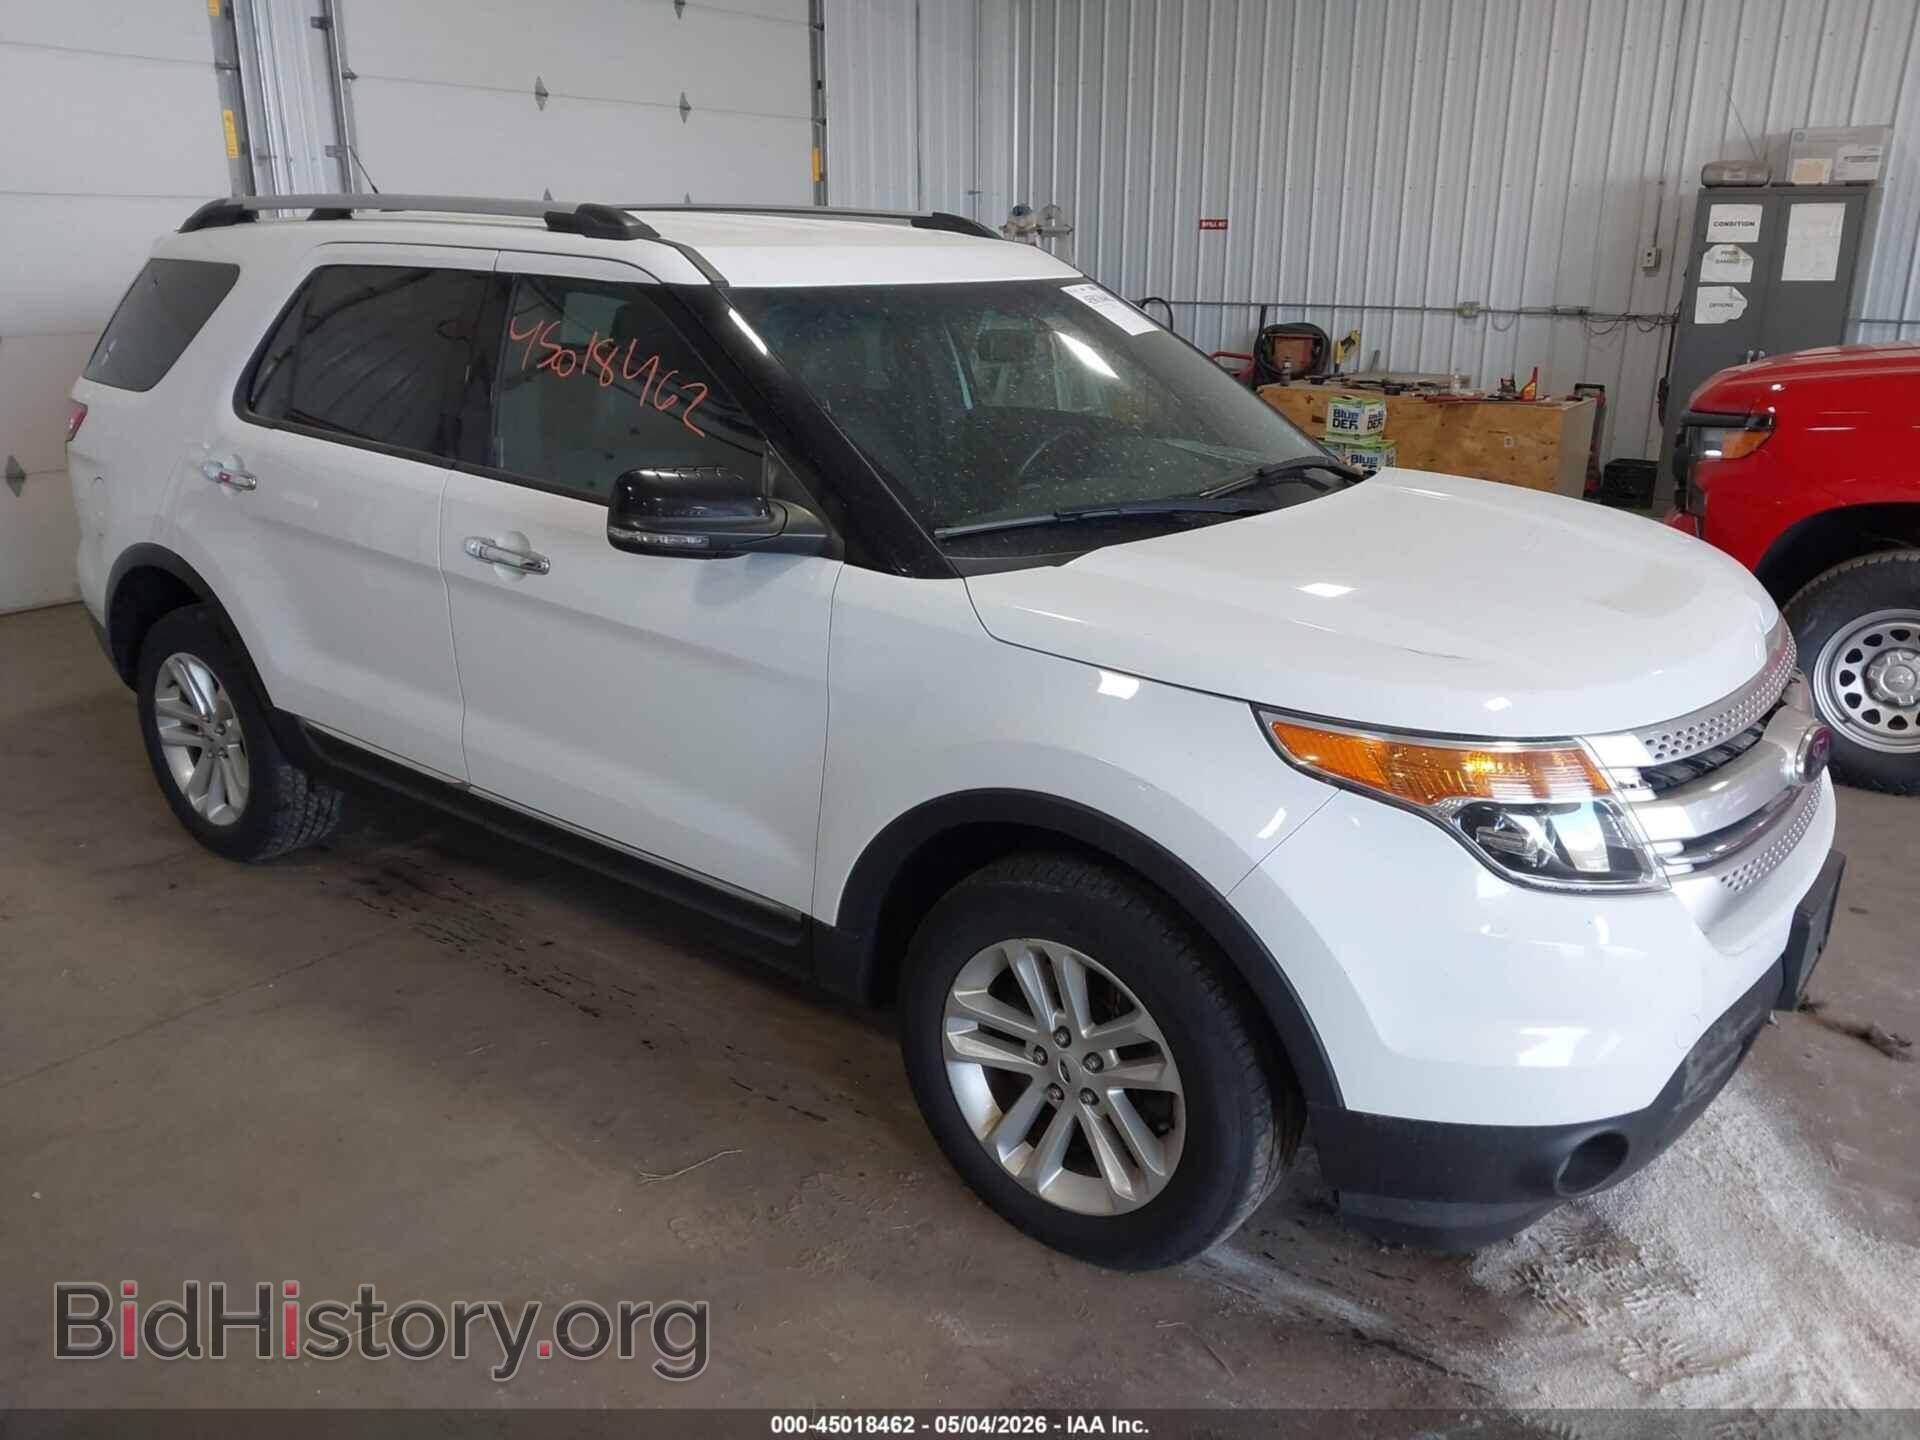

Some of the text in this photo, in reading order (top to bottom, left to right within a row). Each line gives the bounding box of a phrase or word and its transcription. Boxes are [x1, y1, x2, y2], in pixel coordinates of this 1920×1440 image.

[1713, 220, 1755, 228] CONDITION
[510, 319, 708, 437] 45018462
[1333, 408, 1360, 420] Blue
[1351, 454, 1378, 464] Blue
